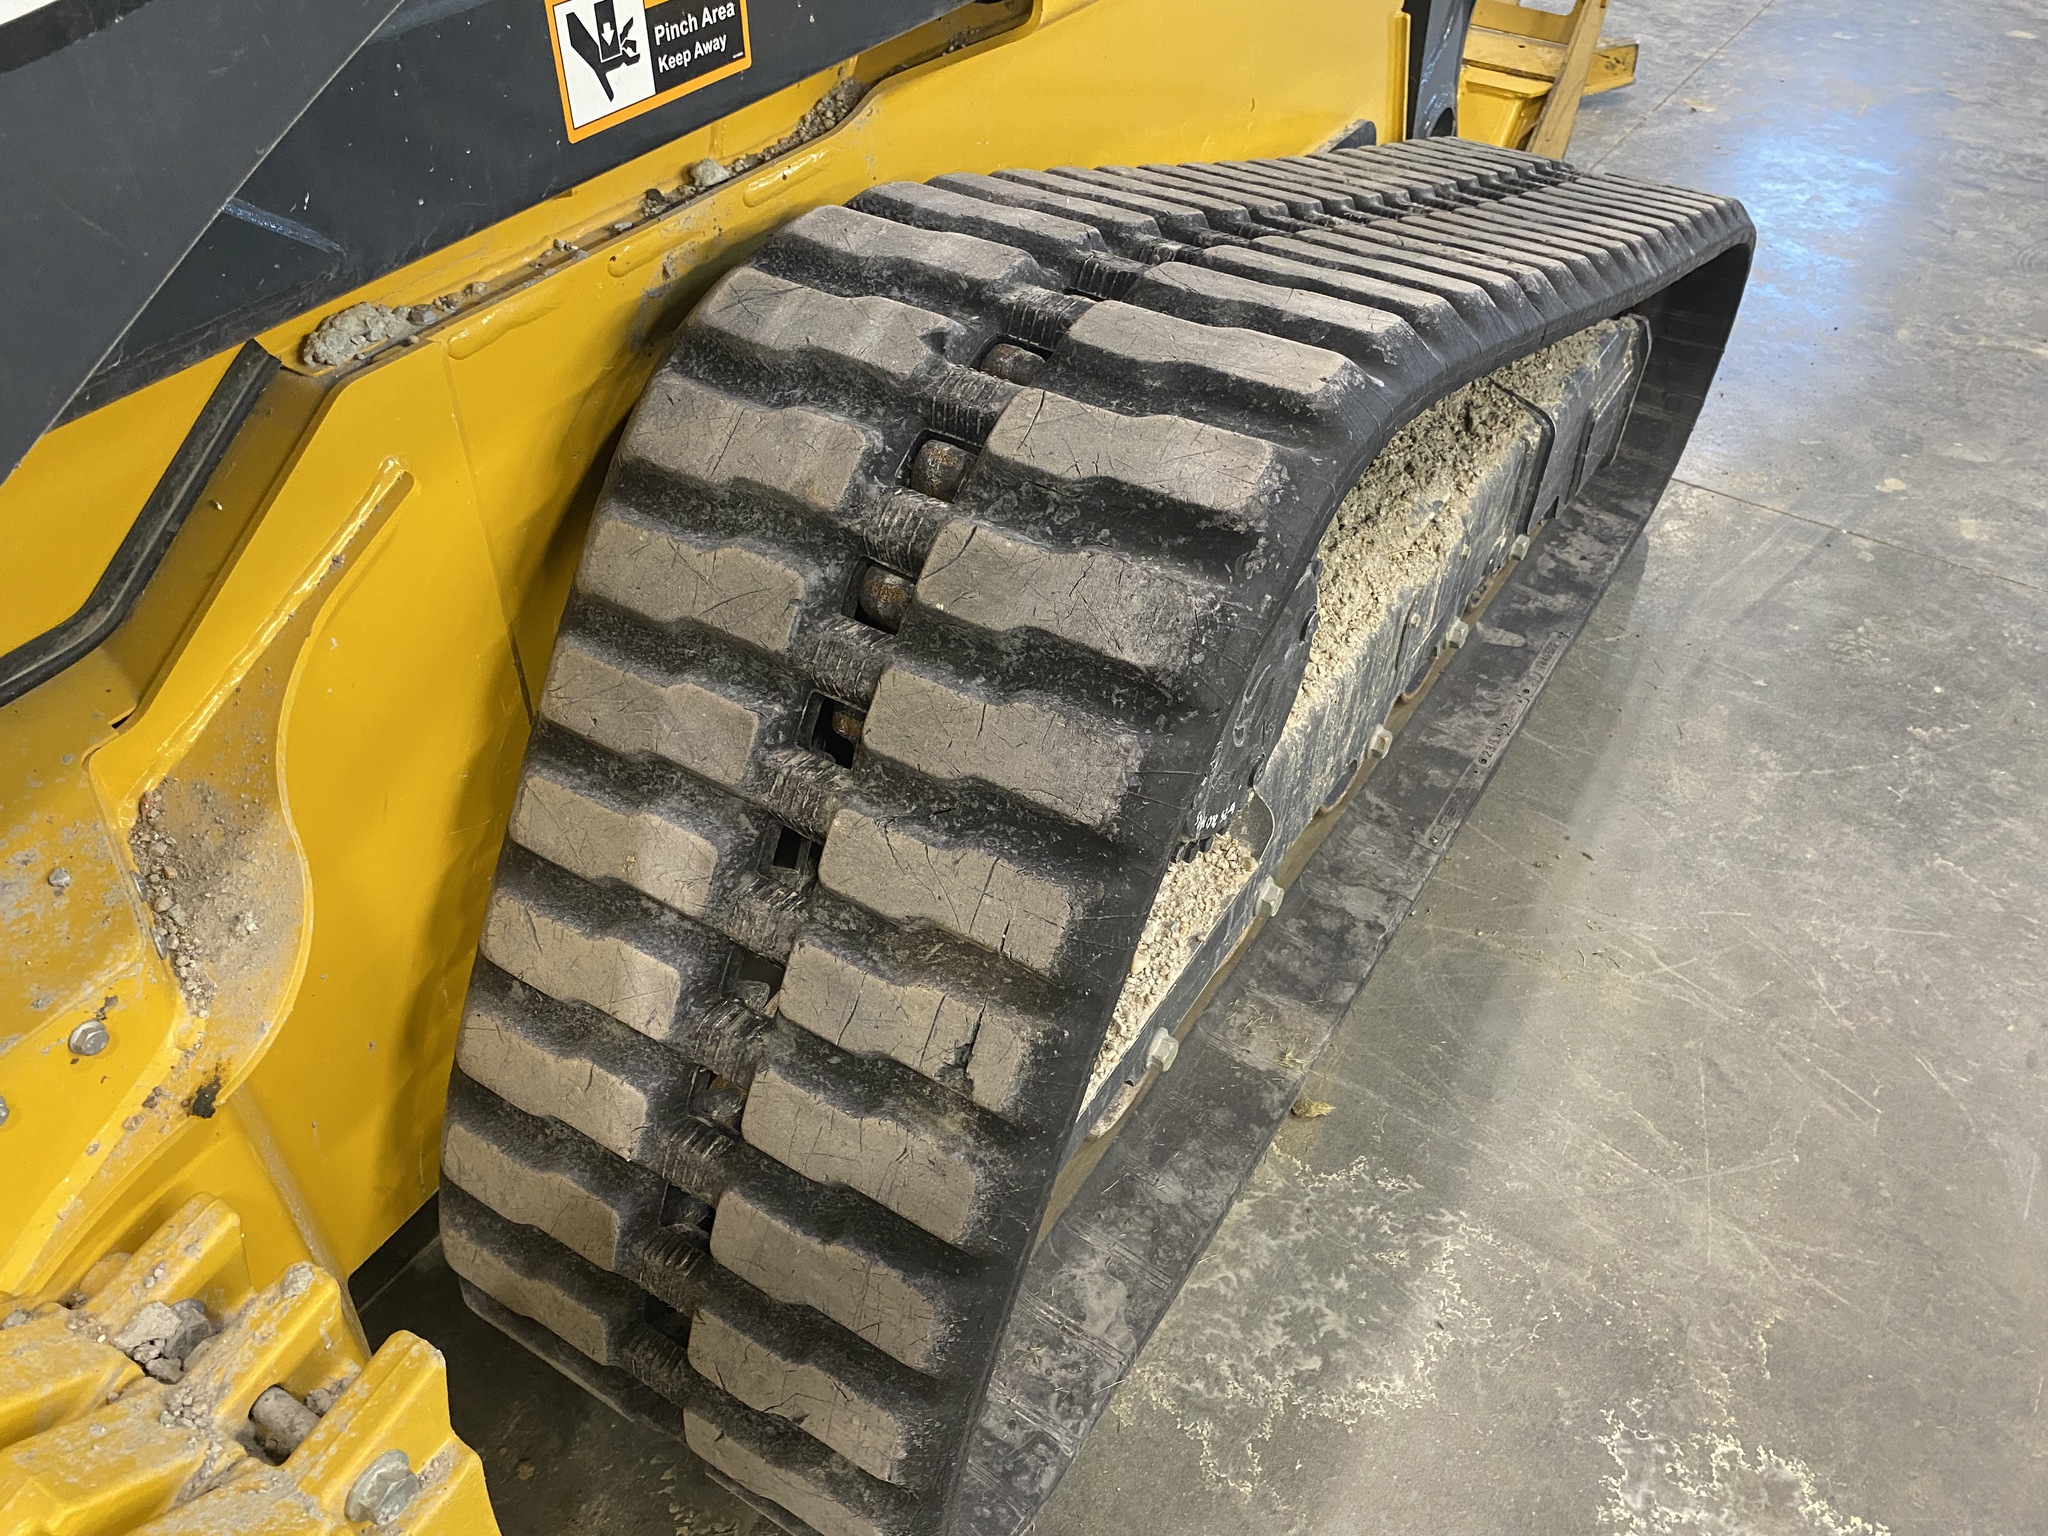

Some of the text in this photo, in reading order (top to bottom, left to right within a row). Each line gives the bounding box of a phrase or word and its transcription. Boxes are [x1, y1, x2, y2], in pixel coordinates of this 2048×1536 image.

[654, 2, 736, 46] Pinch Area
[658, 34, 727, 74] Keep Away
